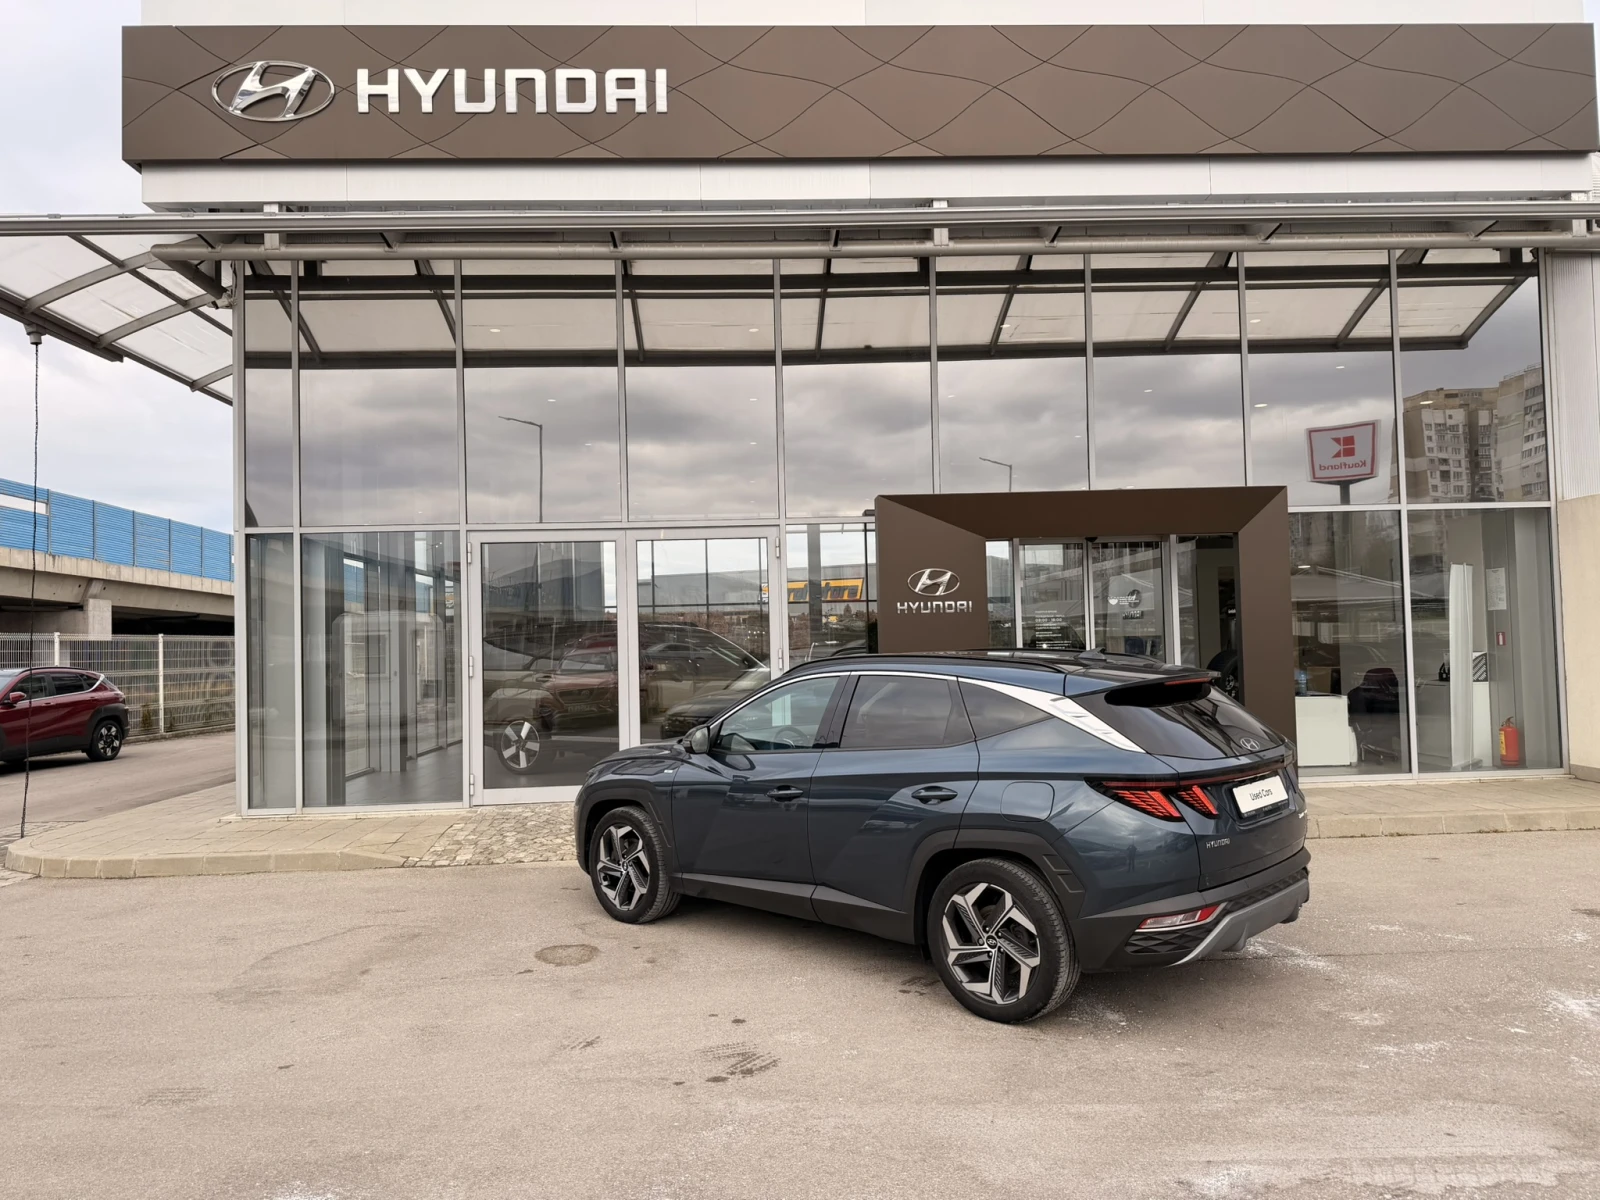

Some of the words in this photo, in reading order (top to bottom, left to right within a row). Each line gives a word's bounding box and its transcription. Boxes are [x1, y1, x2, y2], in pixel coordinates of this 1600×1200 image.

[356, 68, 667, 114] HYUNDAI
[896, 600, 973, 614] HYUNDAI
[1249, 789, 1263, 801] Used
[1261, 788, 1273, 799] Cars
[1205, 838, 1230, 849] HYUNDAI
